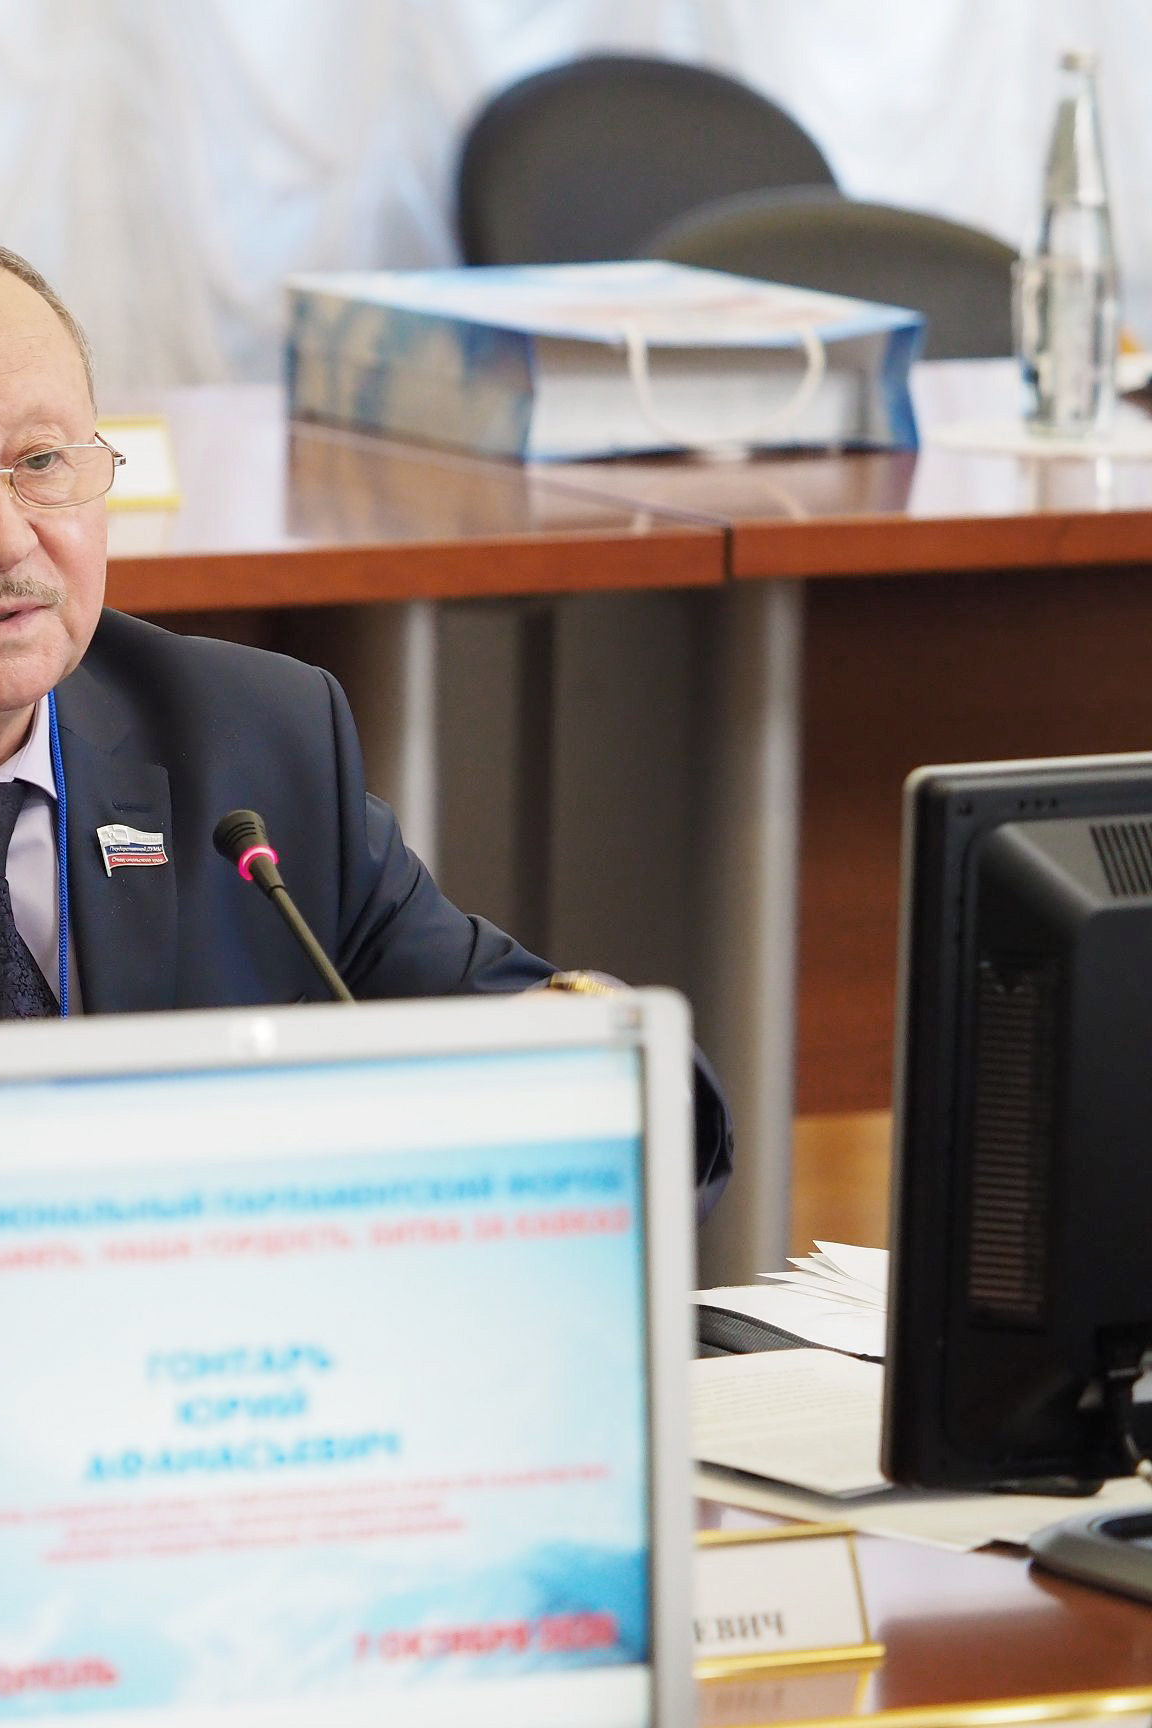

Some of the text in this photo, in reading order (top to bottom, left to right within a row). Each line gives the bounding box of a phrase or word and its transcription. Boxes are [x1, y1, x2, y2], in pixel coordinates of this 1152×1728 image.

[147, 1343, 336, 1386] ГОНТАРЬ
[176, 1386, 309, 1425] ЮРИЙ
[84, 1429, 403, 1482] АФАНАСЬЕВИЧ
